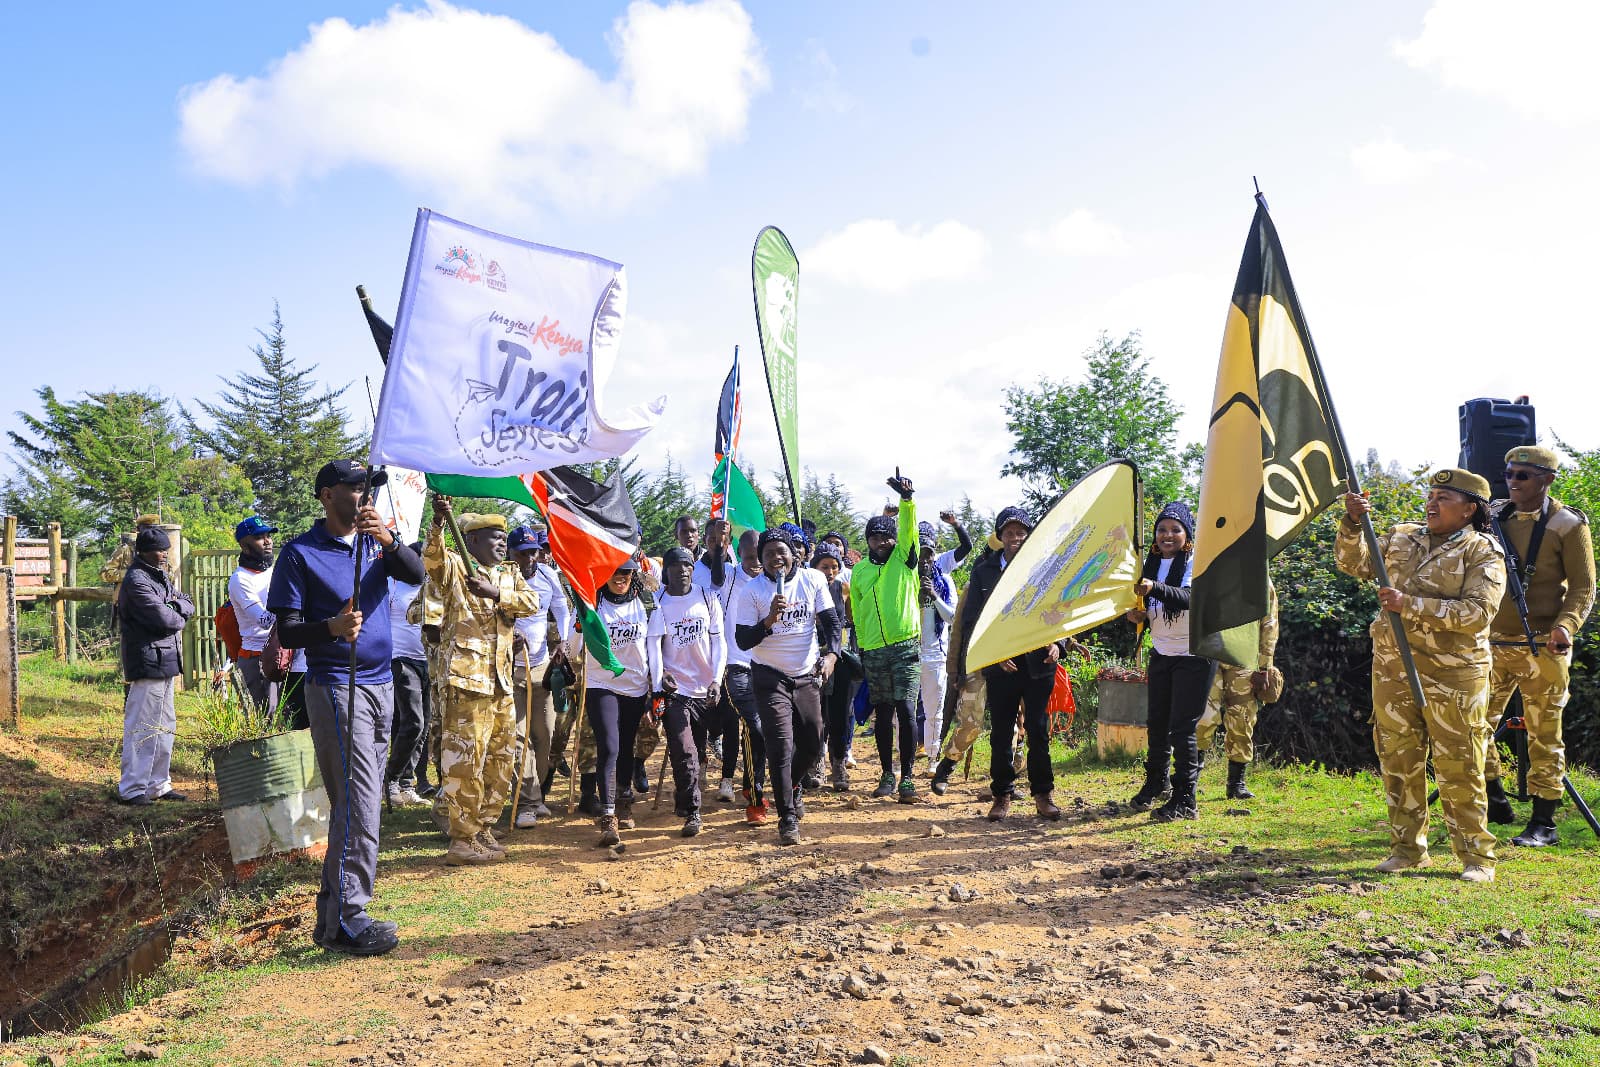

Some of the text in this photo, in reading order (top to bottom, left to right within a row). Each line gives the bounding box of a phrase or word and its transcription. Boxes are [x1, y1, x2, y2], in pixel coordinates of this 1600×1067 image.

[532, 315, 584, 356] Kenya
[495, 340, 587, 431] Trail
[780, 604, 808, 620] Trail
[610, 625, 639, 638] Trail
[675, 620, 702, 636] Trail
